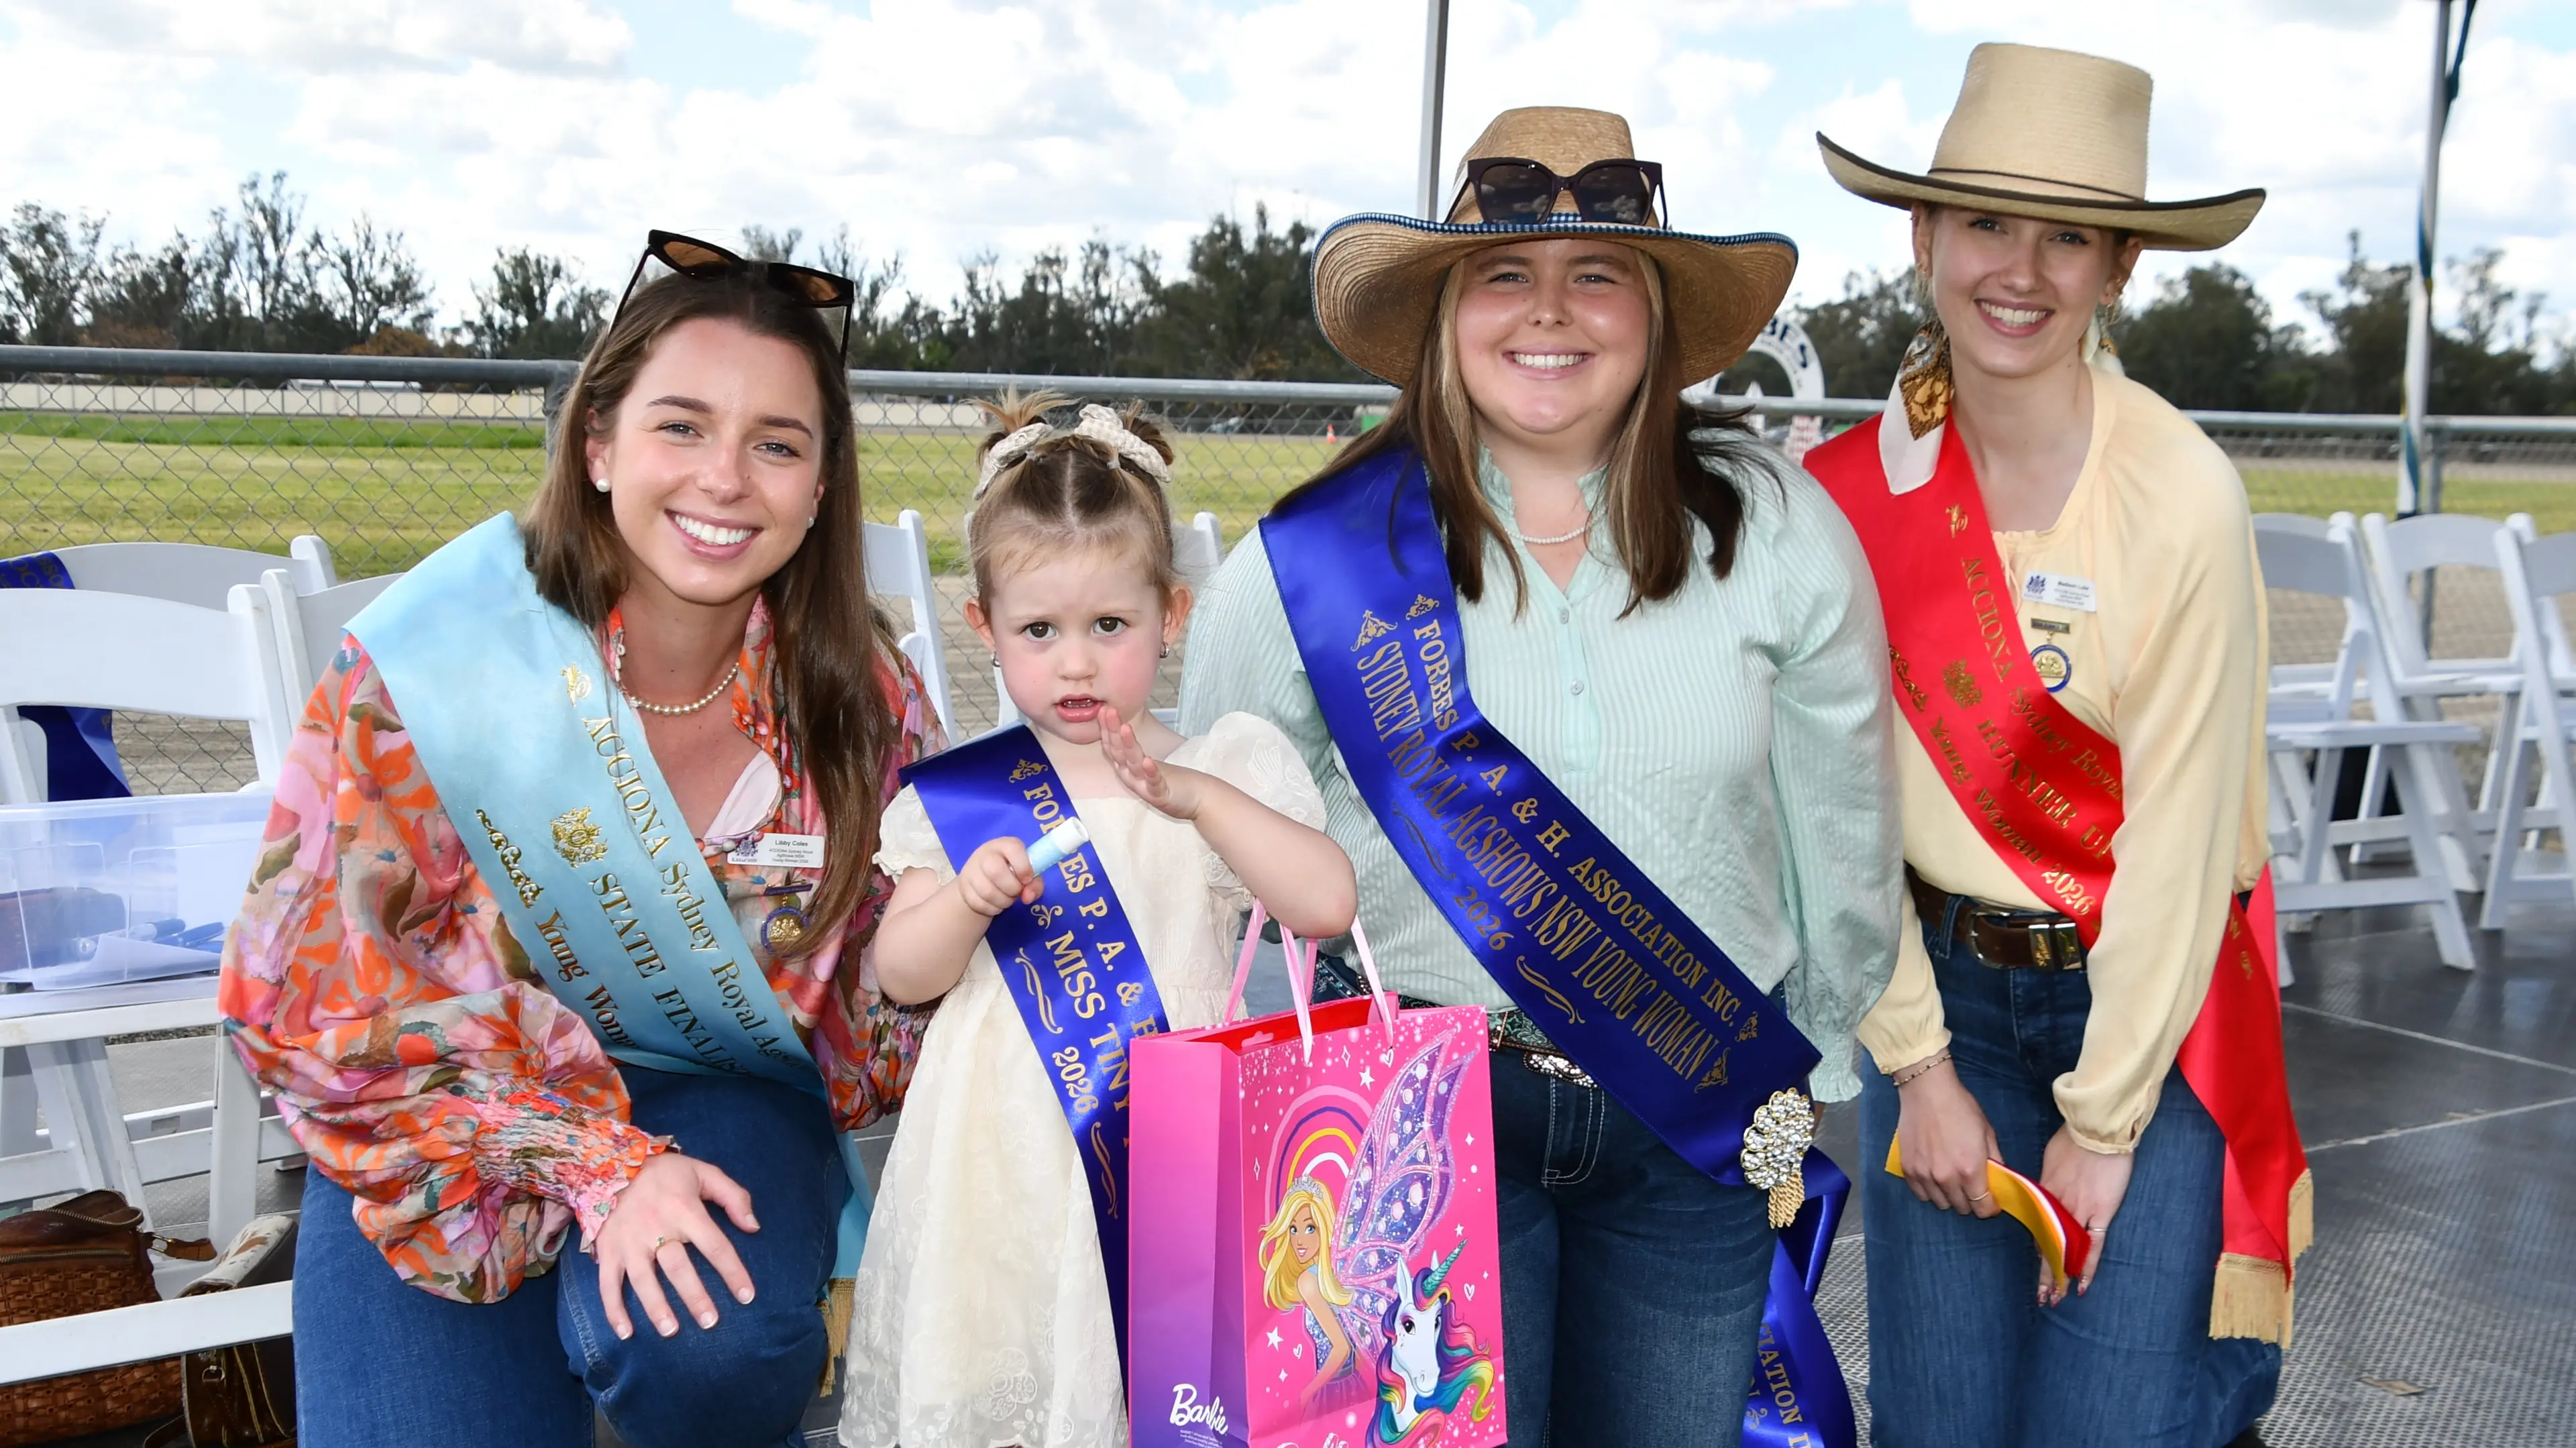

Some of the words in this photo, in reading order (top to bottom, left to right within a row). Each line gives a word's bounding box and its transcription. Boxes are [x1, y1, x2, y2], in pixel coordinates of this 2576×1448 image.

[1356, 641, 1421, 742] SYDNEY
[1962, 557, 2013, 683] ACCIONA
[2009, 685, 2074, 755] Sydney
[1387, 728, 1468, 818] ROYAL
[1413, 619, 1459, 732] FORBES
[1451, 732, 1479, 762] P.
[1480, 763, 1508, 797] A.
[1511, 796, 1538, 824] &
[1536, 820, 1571, 858] H.
[1567, 857, 1709, 990] ASSOCIATION
[1699, 979, 1741, 1027] INC.
[1927, 716, 1973, 786] Young
[1975, 788, 2043, 866] Woman
[2041, 862, 2096, 917] 2026
[1977, 718, 2078, 829] RUNNER
[582, 716, 672, 858] ACCIONA
[661, 861, 719, 952] Sydney
[710, 956, 768, 1031] Royal
[1023, 782, 1095, 893] FOES
[1116, 981, 1144, 1007] &
[1446, 804, 1556, 919] AGSHOWS
[1453, 887, 1514, 951] 2026
[1526, 893, 1603, 962] NSW
[536, 909, 589, 982] Young
[584, 983, 637, 1048] Wom
[590, 873, 666, 979] STATE
[651, 985, 751, 1074] FINALIS
[1044, 930, 1106, 1019] MISS
[1570, 936, 1657, 1019] YOUNG
[1053, 1046, 1099, 1115] 2026
[1631, 991, 1720, 1079] WOMAN
[1169, 1383, 1228, 1435] Barbie
